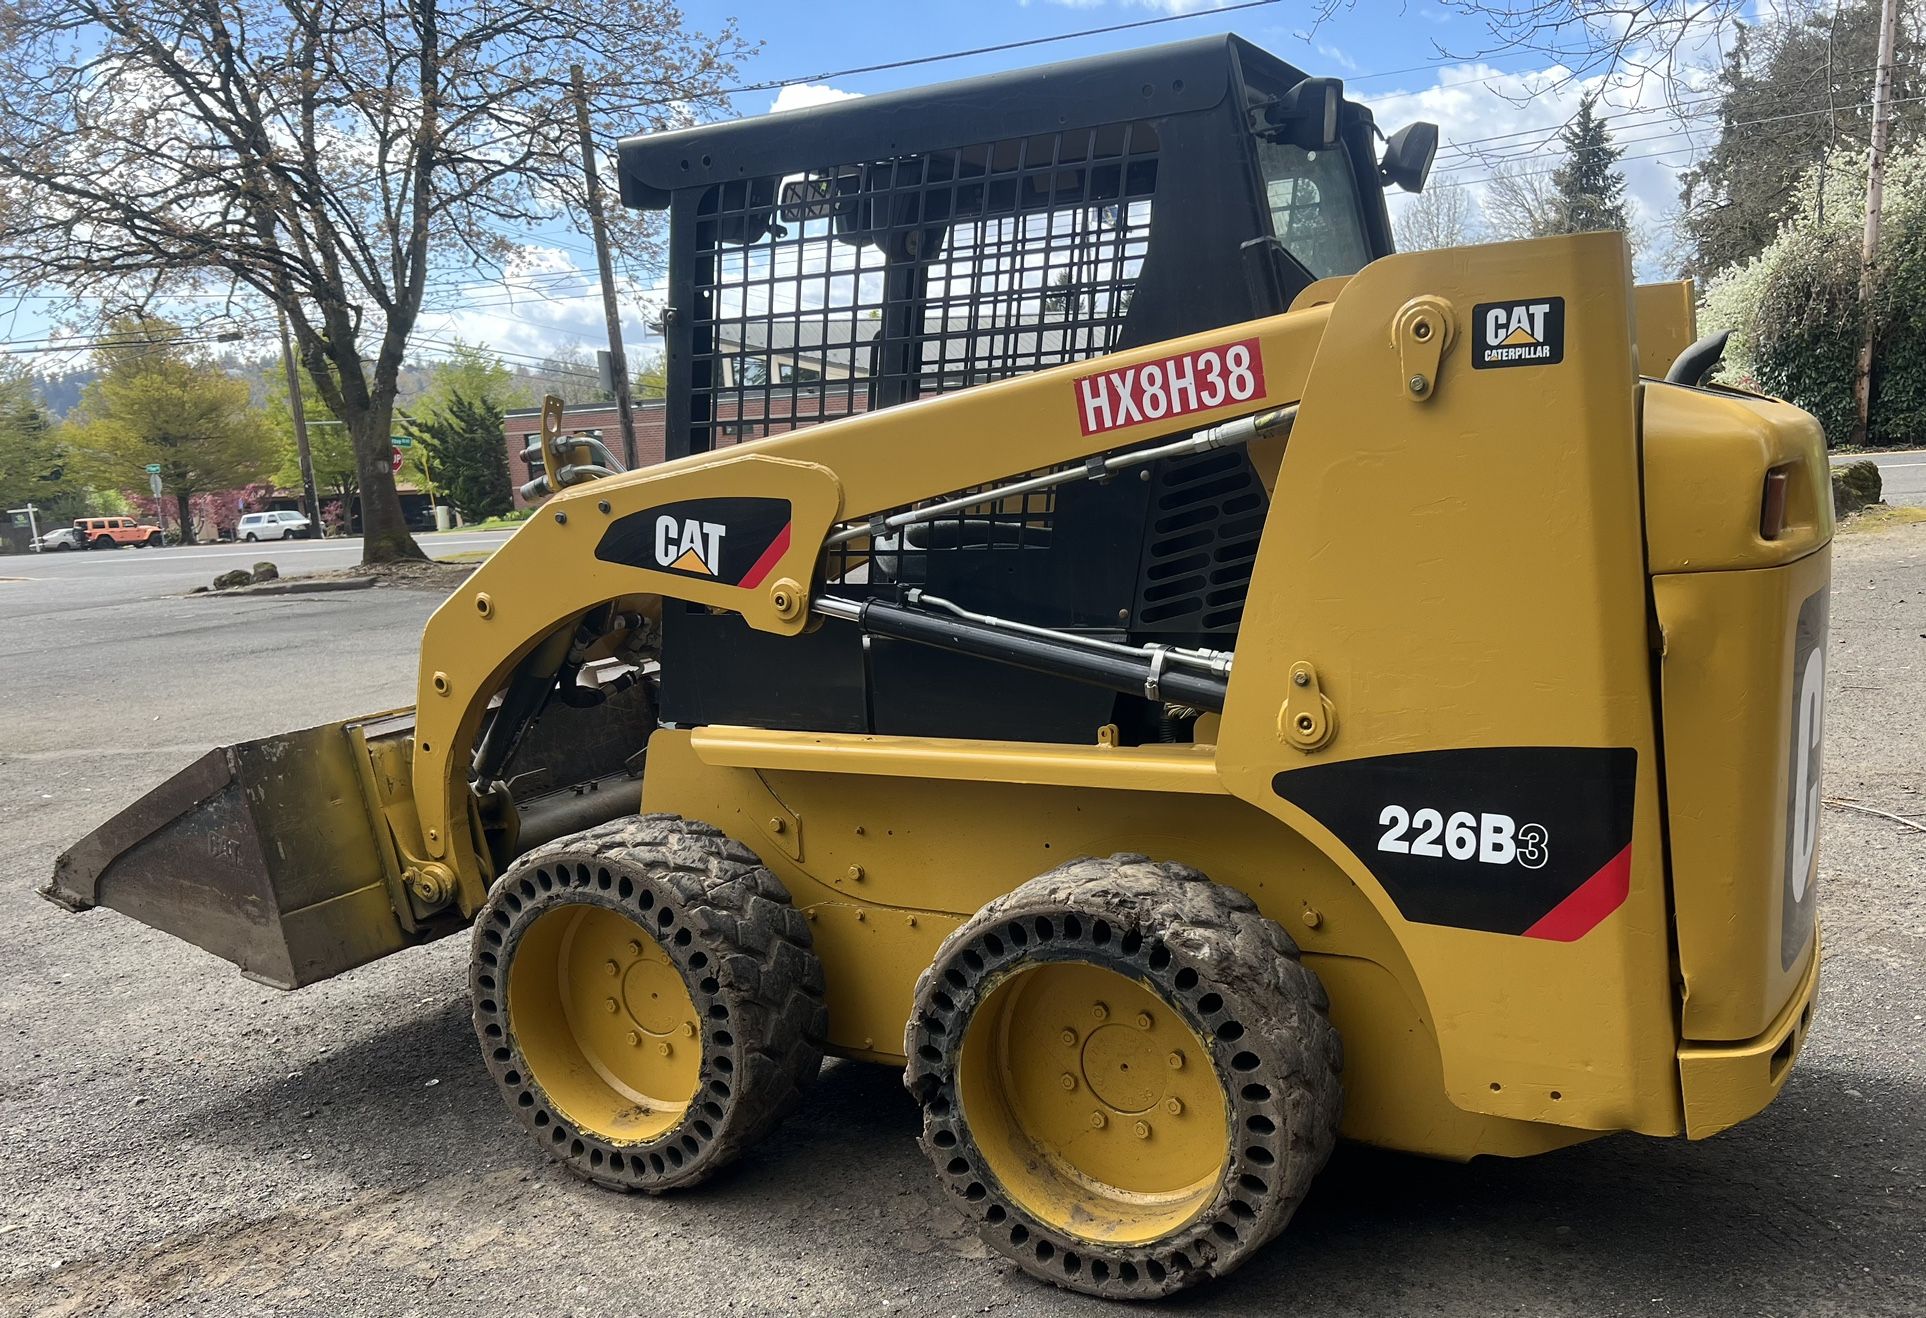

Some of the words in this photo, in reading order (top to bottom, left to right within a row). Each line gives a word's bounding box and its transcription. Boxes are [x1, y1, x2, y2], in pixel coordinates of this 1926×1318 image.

[1484, 346, 1550, 361] CATERPILLAR
[1486, 304, 1550, 346] CAT
[1081, 344, 1256, 431] HX8H38
[655, 515, 726, 576] CAT
[1377, 804, 1549, 869] 226B3
